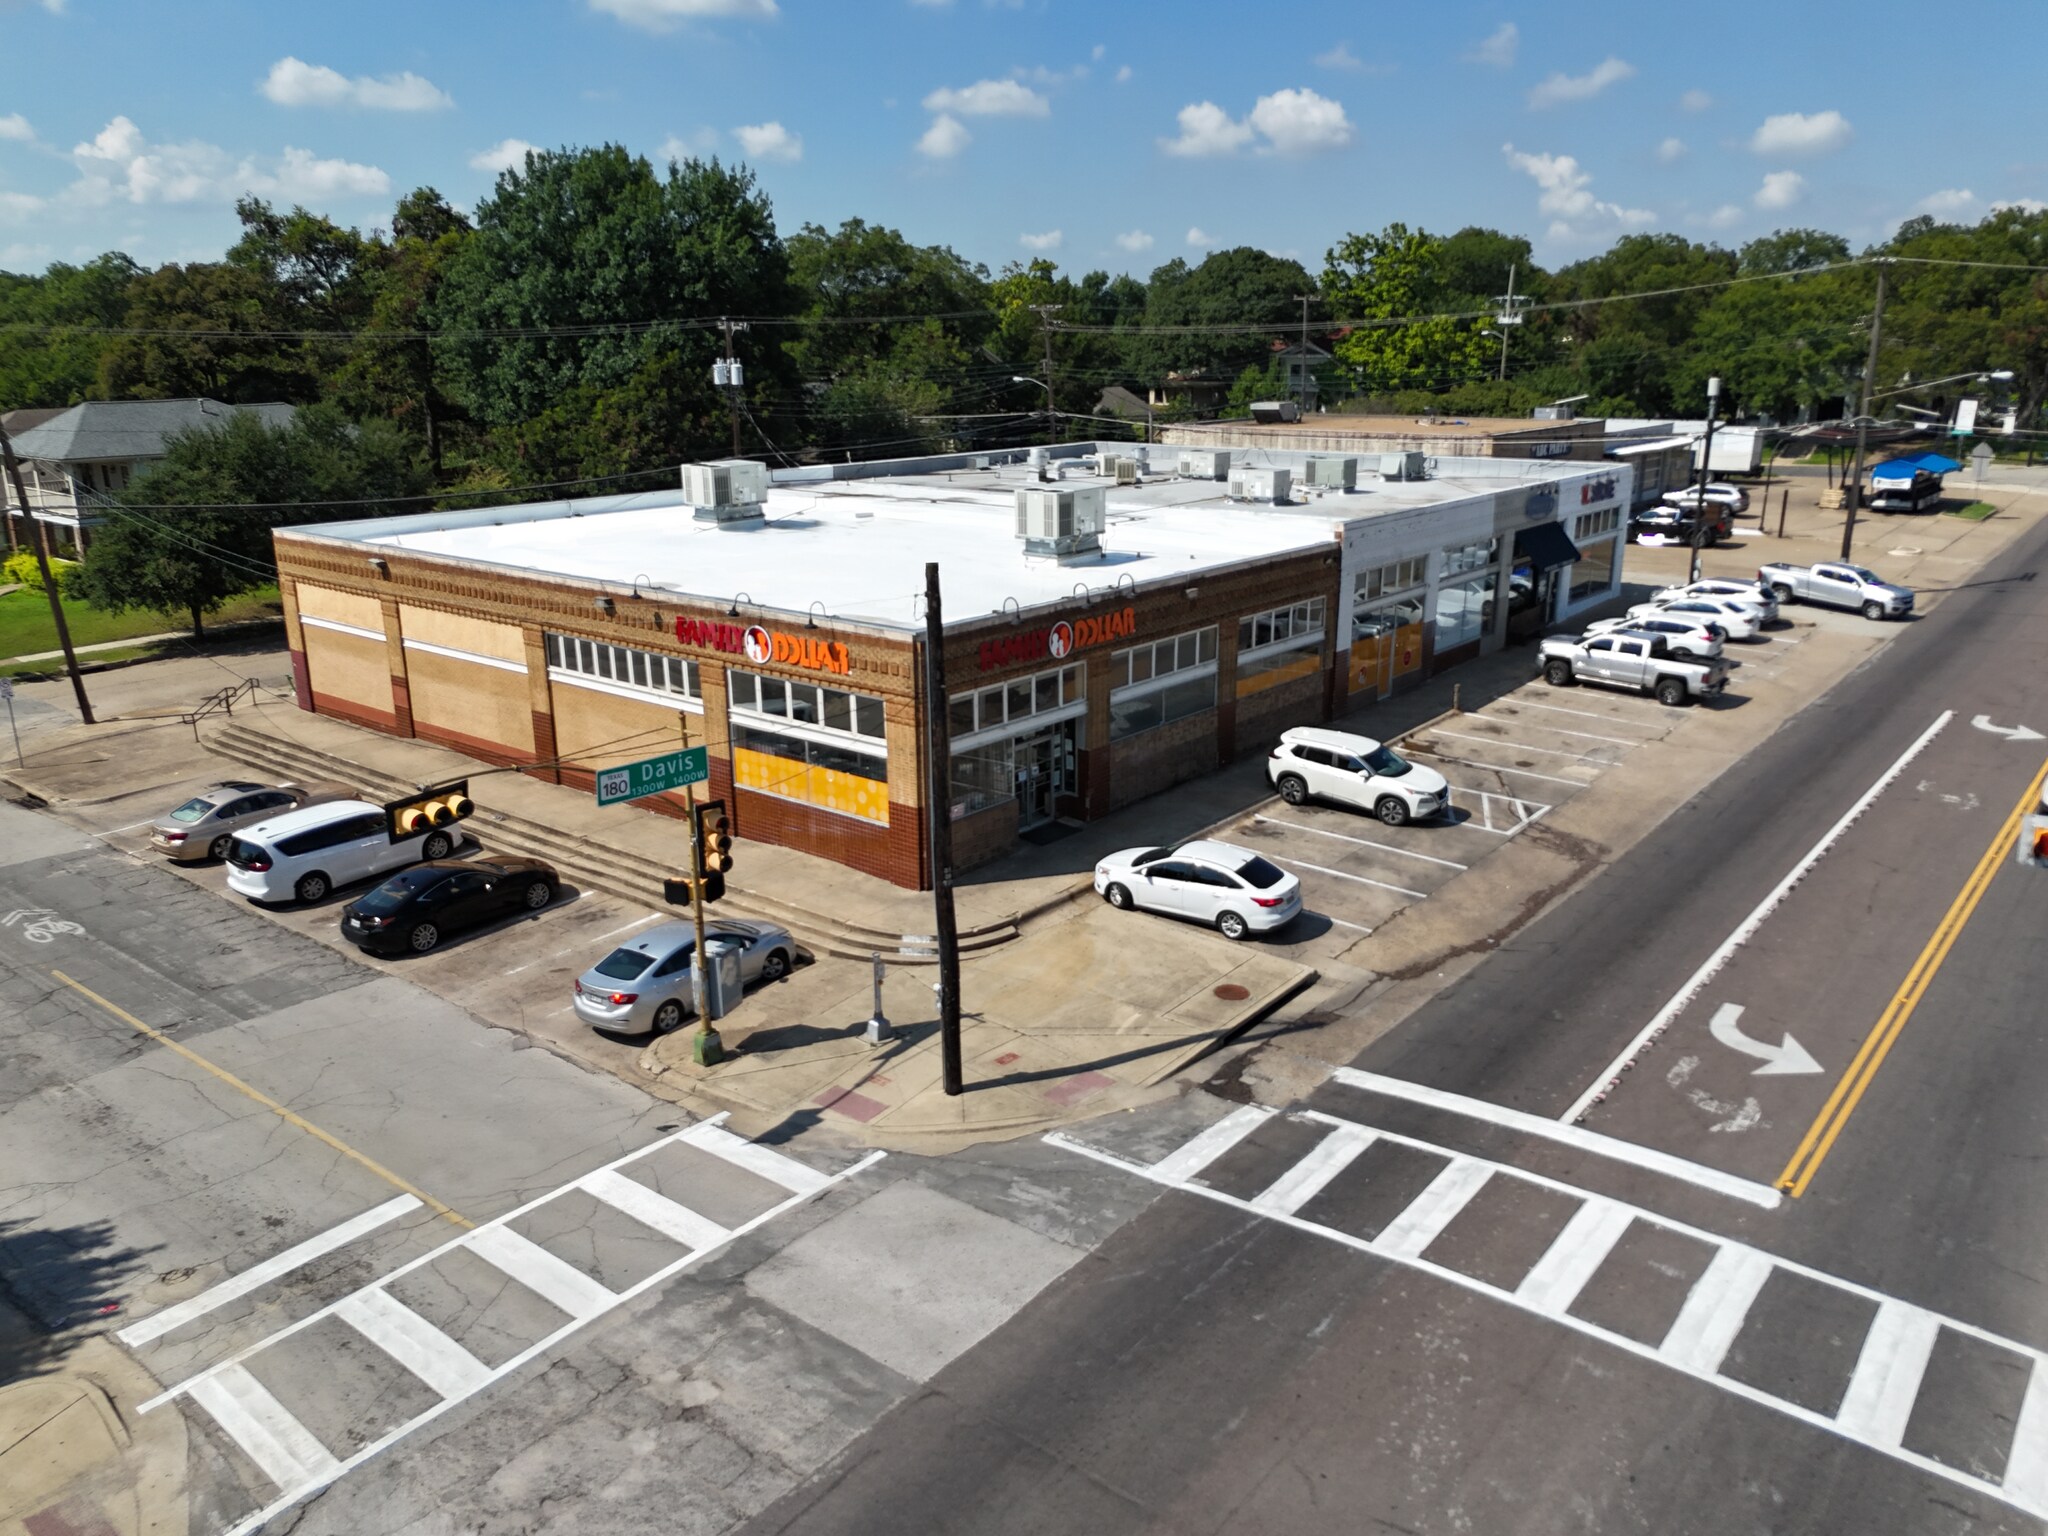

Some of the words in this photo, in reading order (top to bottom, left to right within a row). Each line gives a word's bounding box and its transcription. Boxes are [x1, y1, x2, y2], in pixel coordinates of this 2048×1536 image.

[676, 616, 745, 654] FAMILY
[772, 632, 849, 675] DOLLAR
[980, 628, 1049, 672] FAMILY
[1074, 607, 1135, 648] DOLLAR
[607, 773, 624, 781] TEXAS
[642, 754, 694, 781] Davis
[603, 780, 628, 797] 180
[632, 780, 666, 796] 1300W
[673, 769, 706, 785] 1400W
